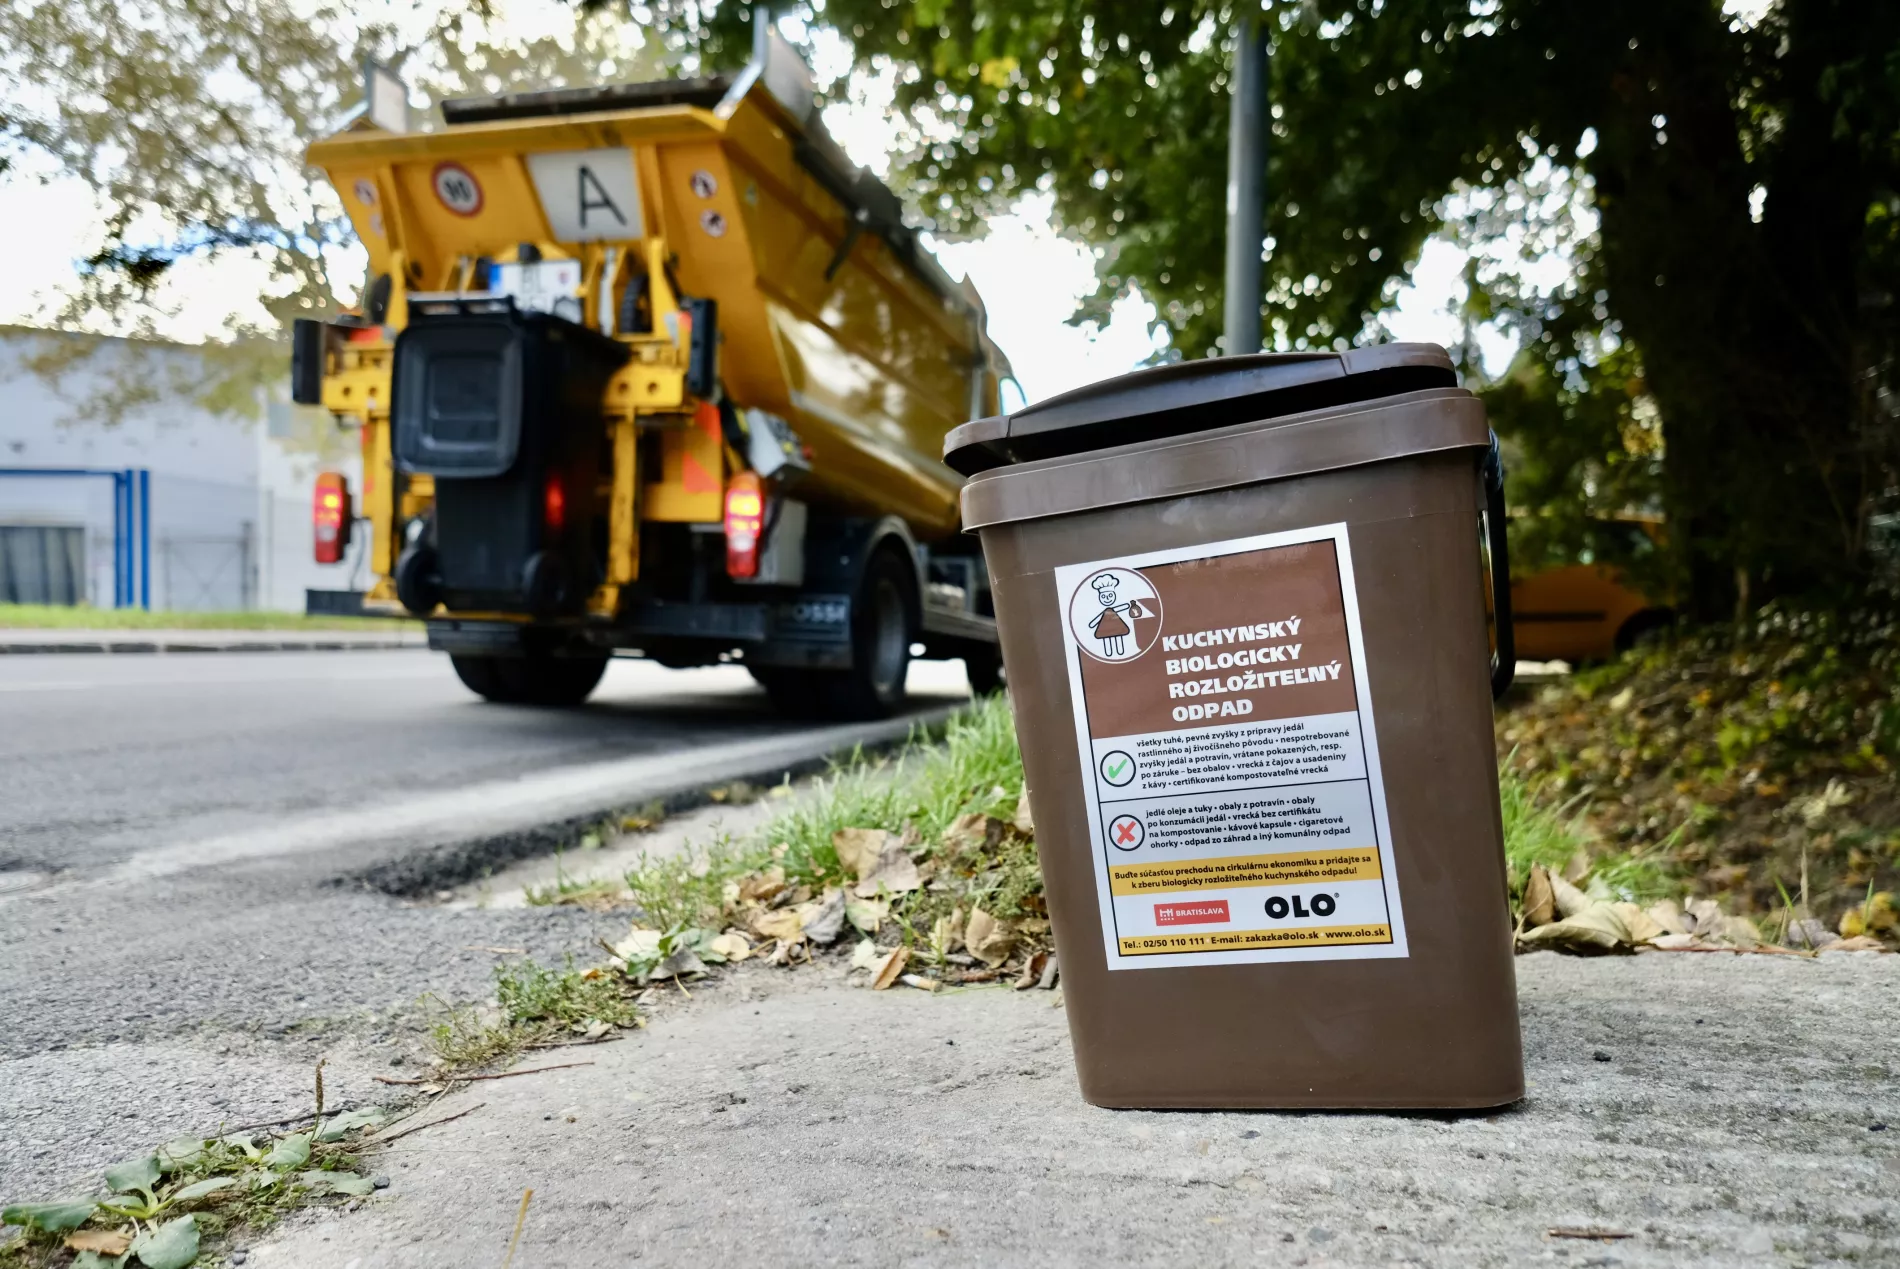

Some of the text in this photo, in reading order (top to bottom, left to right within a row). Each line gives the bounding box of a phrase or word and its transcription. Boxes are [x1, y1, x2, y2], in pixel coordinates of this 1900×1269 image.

[579, 164, 628, 229] A
[1162, 615, 1302, 652] KUCHYNSKÝ
[1165, 643, 1302, 675] BIOLOGICKY
[1168, 660, 1342, 699] ROZLOŽITEĽNÝ
[1172, 698, 1254, 722] ODPAD
[1136, 738, 1162, 747] všetky
[1162, 735, 1184, 745] tuhé,
[1185, 732, 1210, 744] pevné
[1211, 729, 1239, 740] zvyšky
[1283, 722, 1304, 734] jedál
[1137, 746, 1183, 758] rastlinného
[1183, 745, 1192, 755] aj
[1241, 736, 1274, 749] pôvodu
[1279, 729, 1350, 744] nespotrebované
[1139, 759, 1166, 769] zvyšky
[1166, 756, 1187, 767] jedál
[1194, 752, 1232, 764] potravín,
[1232, 750, 1265, 759] vrátane
[1265, 743, 1319, 757] pokazených,
[1320, 743, 1342, 751] resp.
[1140, 772, 1151, 780] po
[1152, 768, 1179, 778] záruke
[1186, 766, 1202, 774] bez
[1202, 763, 1230, 773] obalov
[1236, 759, 1264, 769] vrecká
[1271, 757, 1294, 767] čajov
[1302, 752, 1346, 763] usadeniny
[1147, 780, 1167, 789] kávy
[1172, 773, 1225, 787] certifikované
[1299, 764, 1329, 774] vrecká
[1145, 807, 1166, 819] jedlé
[1166, 806, 1187, 816] oleje
[1193, 804, 1213, 814] tuky
[1218, 801, 1242, 811] obaly
[1248, 797, 1285, 810] potravín
[1291, 795, 1315, 805] obaly
[1147, 821, 1158, 829] po
[1205, 813, 1227, 825] jedál
[1231, 810, 1260, 821] vrecká
[1260, 810, 1277, 818] bez
[1277, 806, 1321, 817] certifikátu
[1149, 839, 1179, 849] ohorky
[1184, 836, 1211, 847] odpad
[1222, 833, 1252, 843] záhrad
[1258, 831, 1273, 842] iný
[1273, 828, 1321, 839] komunálny
[1322, 825, 1351, 836] odpad
[1159, 824, 1222, 838] kompostovanie
[1227, 821, 1258, 832] kávové
[1258, 819, 1292, 830] kapsule
[1297, 815, 1344, 828] cigaretové
[1137, 880, 1161, 888] zberu
[1161, 876, 1203, 887] biologicky
[1263, 868, 1320, 880] kuchynského
[1320, 866, 1357, 877] odpadu!
[1175, 864, 1214, 877] prechodu
[1226, 861, 1269, 871] cirkulárnu
[1269, 857, 1317, 869] ekonomiku
[1325, 855, 1360, 866] pridajte
[1175, 907, 1225, 917] BRATISLAVA
[1122, 927, 1385, 949] Tel.: 02/50 110 111 E-mail: zakazka@olo.sk www.olo.sk
